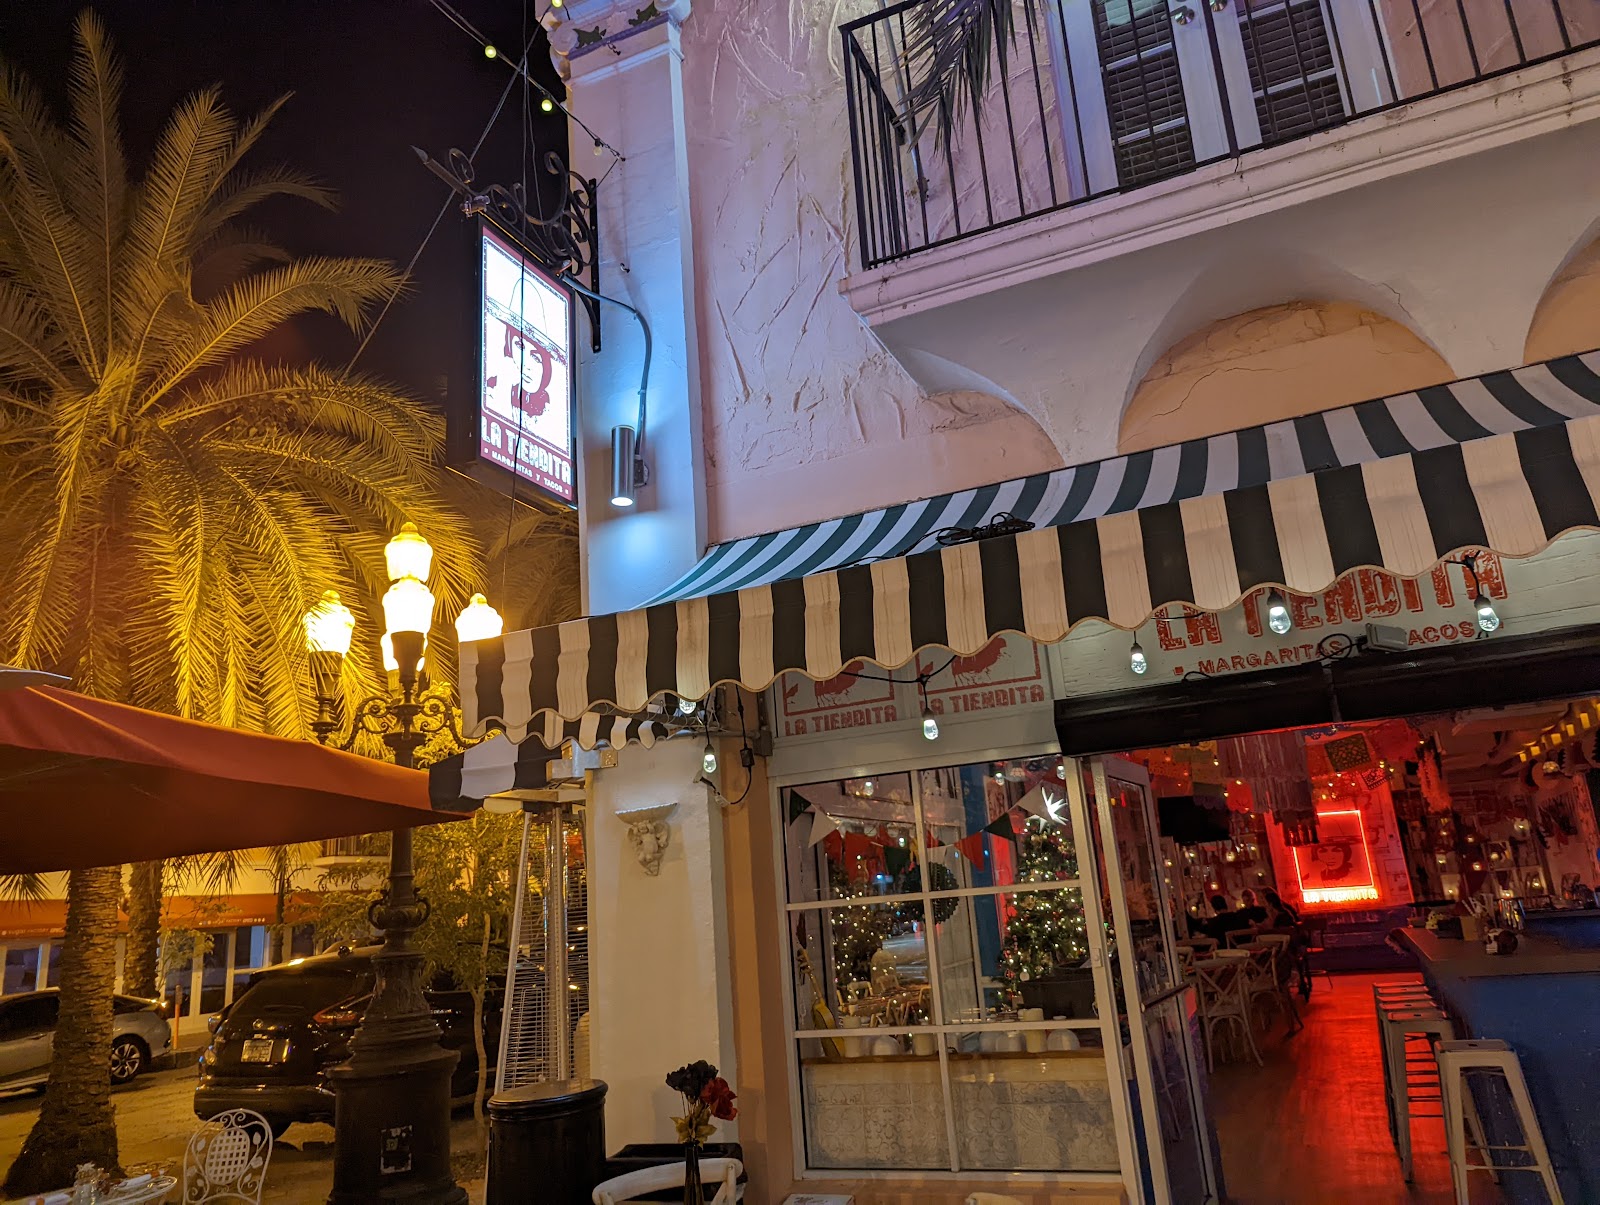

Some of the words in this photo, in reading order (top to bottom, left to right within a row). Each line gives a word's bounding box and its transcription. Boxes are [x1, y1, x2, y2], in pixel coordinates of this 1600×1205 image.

[481, 415, 502, 449] LA
[505, 428, 572, 486] TIENDITA
[543, 477, 563, 493] TACOS
[1198, 639, 1343, 675] MARGARITAS
[1407, 620, 1475, 646] ACOS
[952, 684, 1045, 712] TIENDITA
[784, 719, 807, 737] LA
[811, 704, 897, 732] TIENDITA
